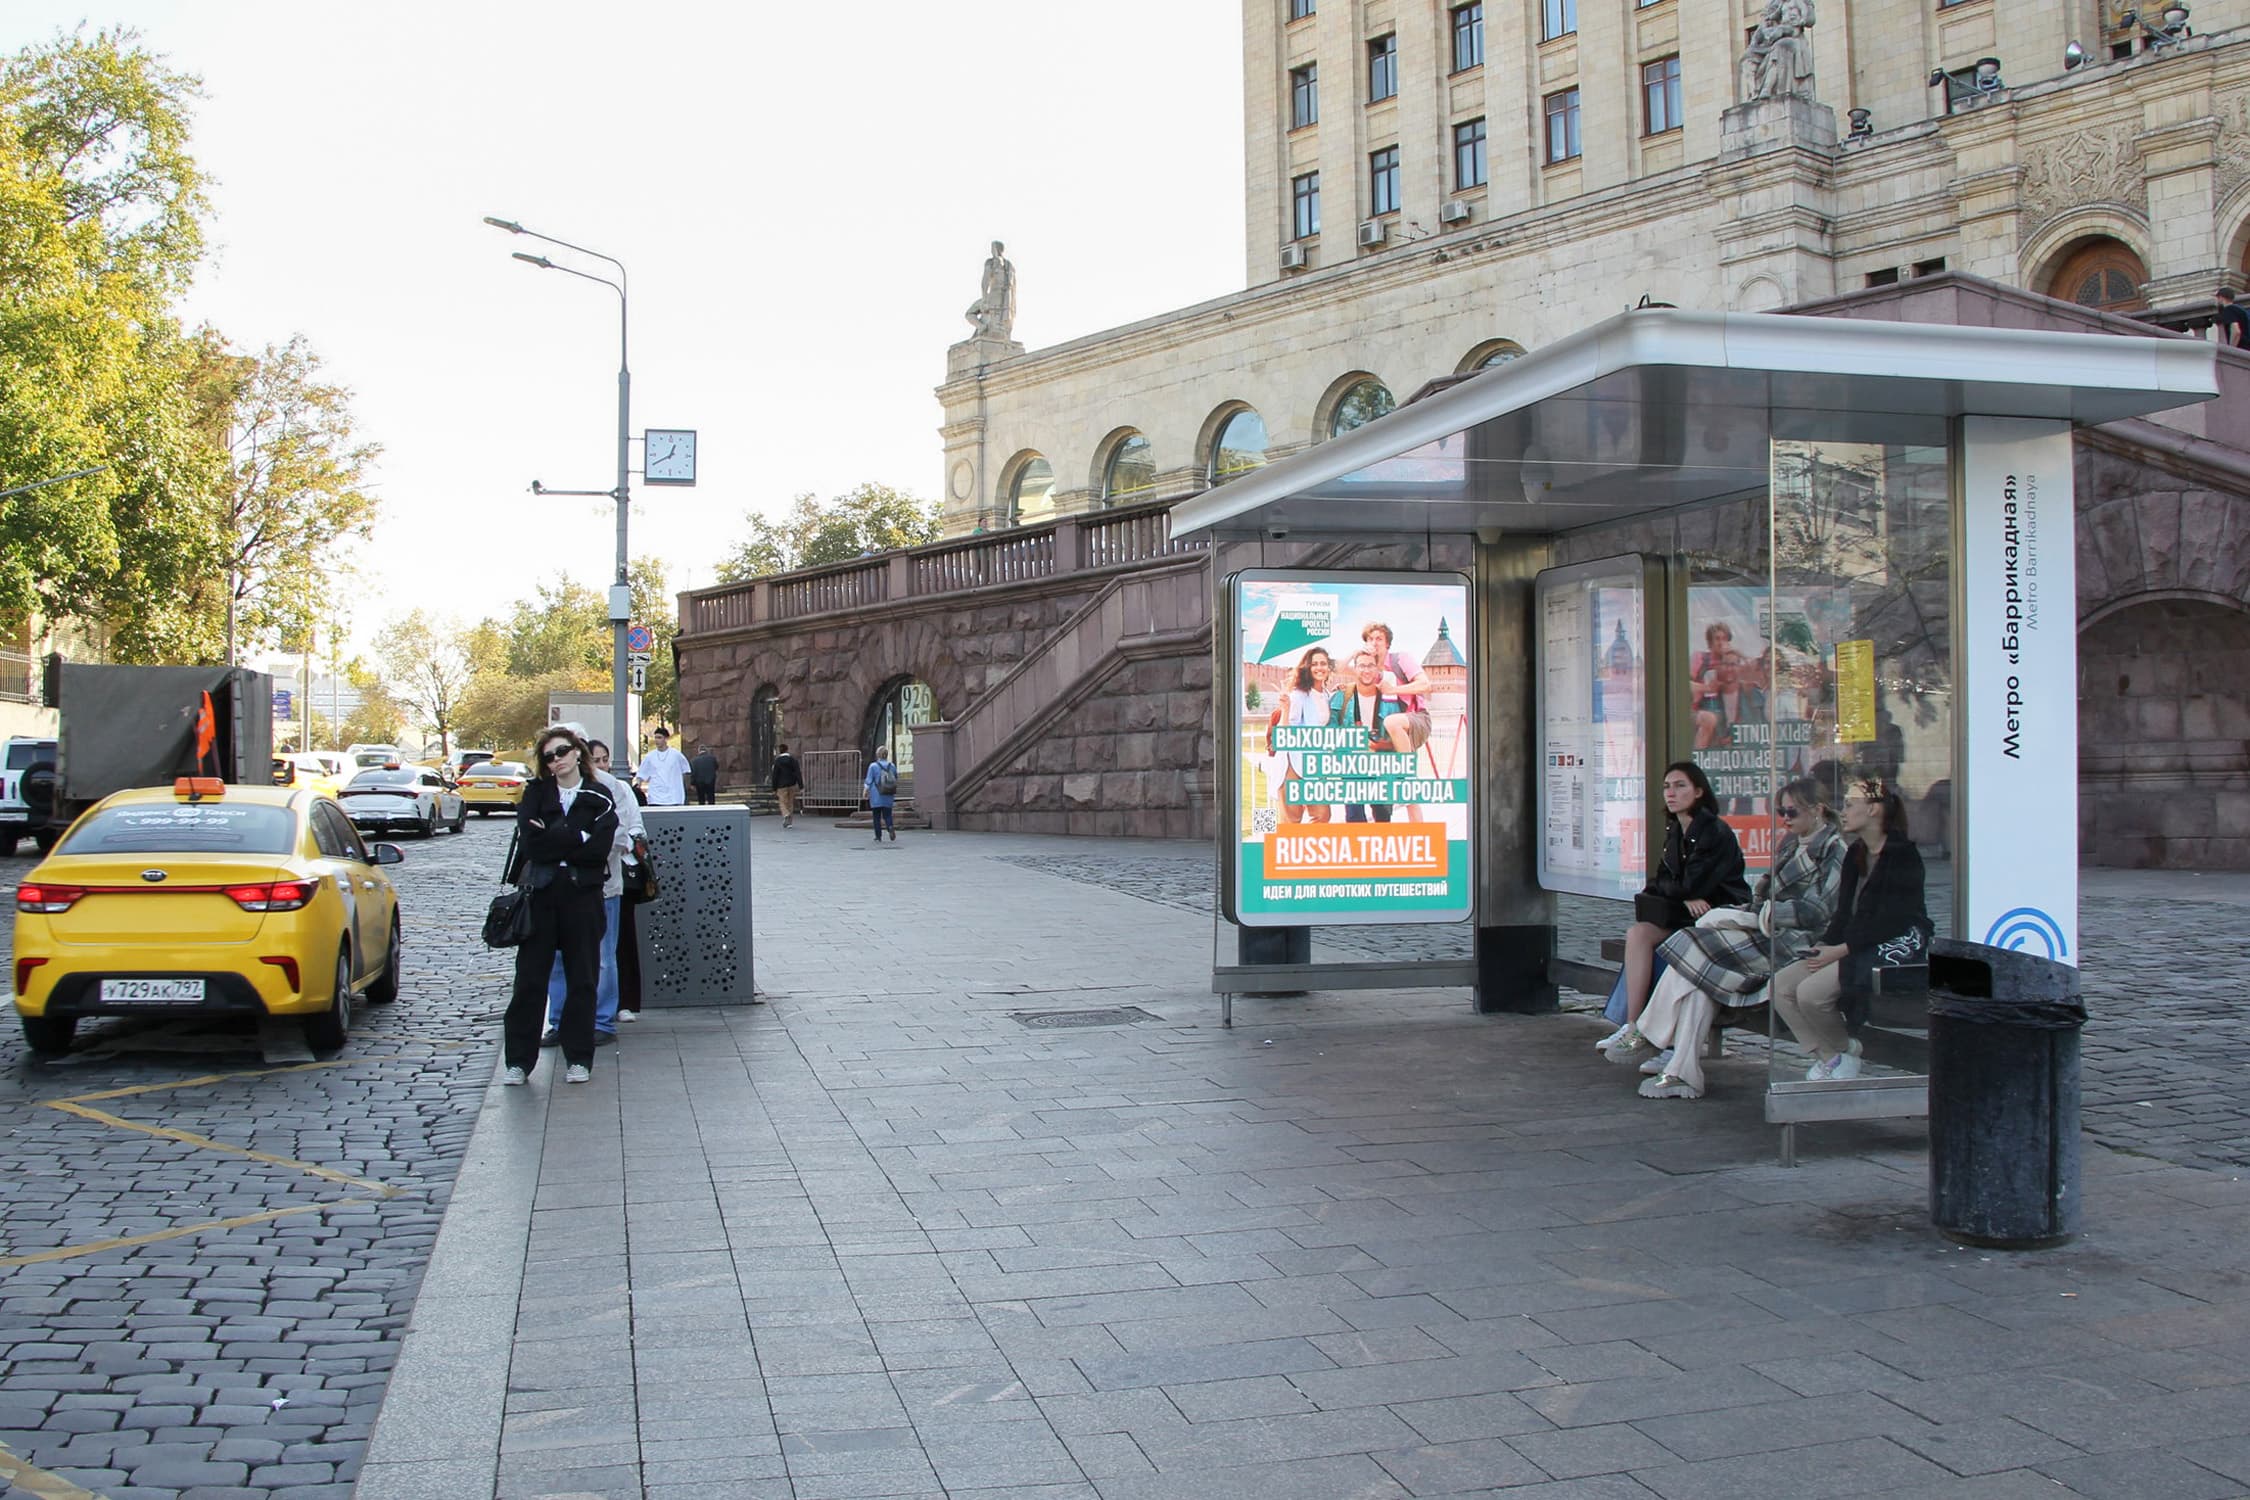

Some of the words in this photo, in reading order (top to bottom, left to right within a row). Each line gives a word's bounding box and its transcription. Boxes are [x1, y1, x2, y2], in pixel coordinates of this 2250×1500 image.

[2023, 473, 2039, 577] Barrikadnaya
[2001, 473, 2023, 665] «Баррикадная»
[1280, 611, 1330, 620] НАЦИОНАЛЬНЫЕ
[2026, 582, 2038, 631] Metro
[1301, 620, 1330, 628] ПРОЕКТЫ
[1306, 628, 1330, 636] РОССИИ
[903, 686, 930, 710] 926
[2002, 675, 2023, 760] Метро
[1275, 727, 1366, 750] ВЫХОДИТЕ
[1306, 756, 1317, 775] В
[1321, 754, 1416, 777] ВЫХОДНЫЕ
[1289, 782, 1299, 802] В
[1304, 781, 1388, 804] СОСЕДНИЕ
[1393, 780, 1454, 803] ГОРОДА
[1275, 835, 1437, 865] RUSSIA.TRAVEL
[1263, 885, 1292, 900] ИДЕИ
[1294, 885, 1317, 900] ДЛЯ
[1319, 884, 1372, 899] КОРОТКИХ
[1374, 881, 1448, 898] ПУТЕШЕСТВИЙ
